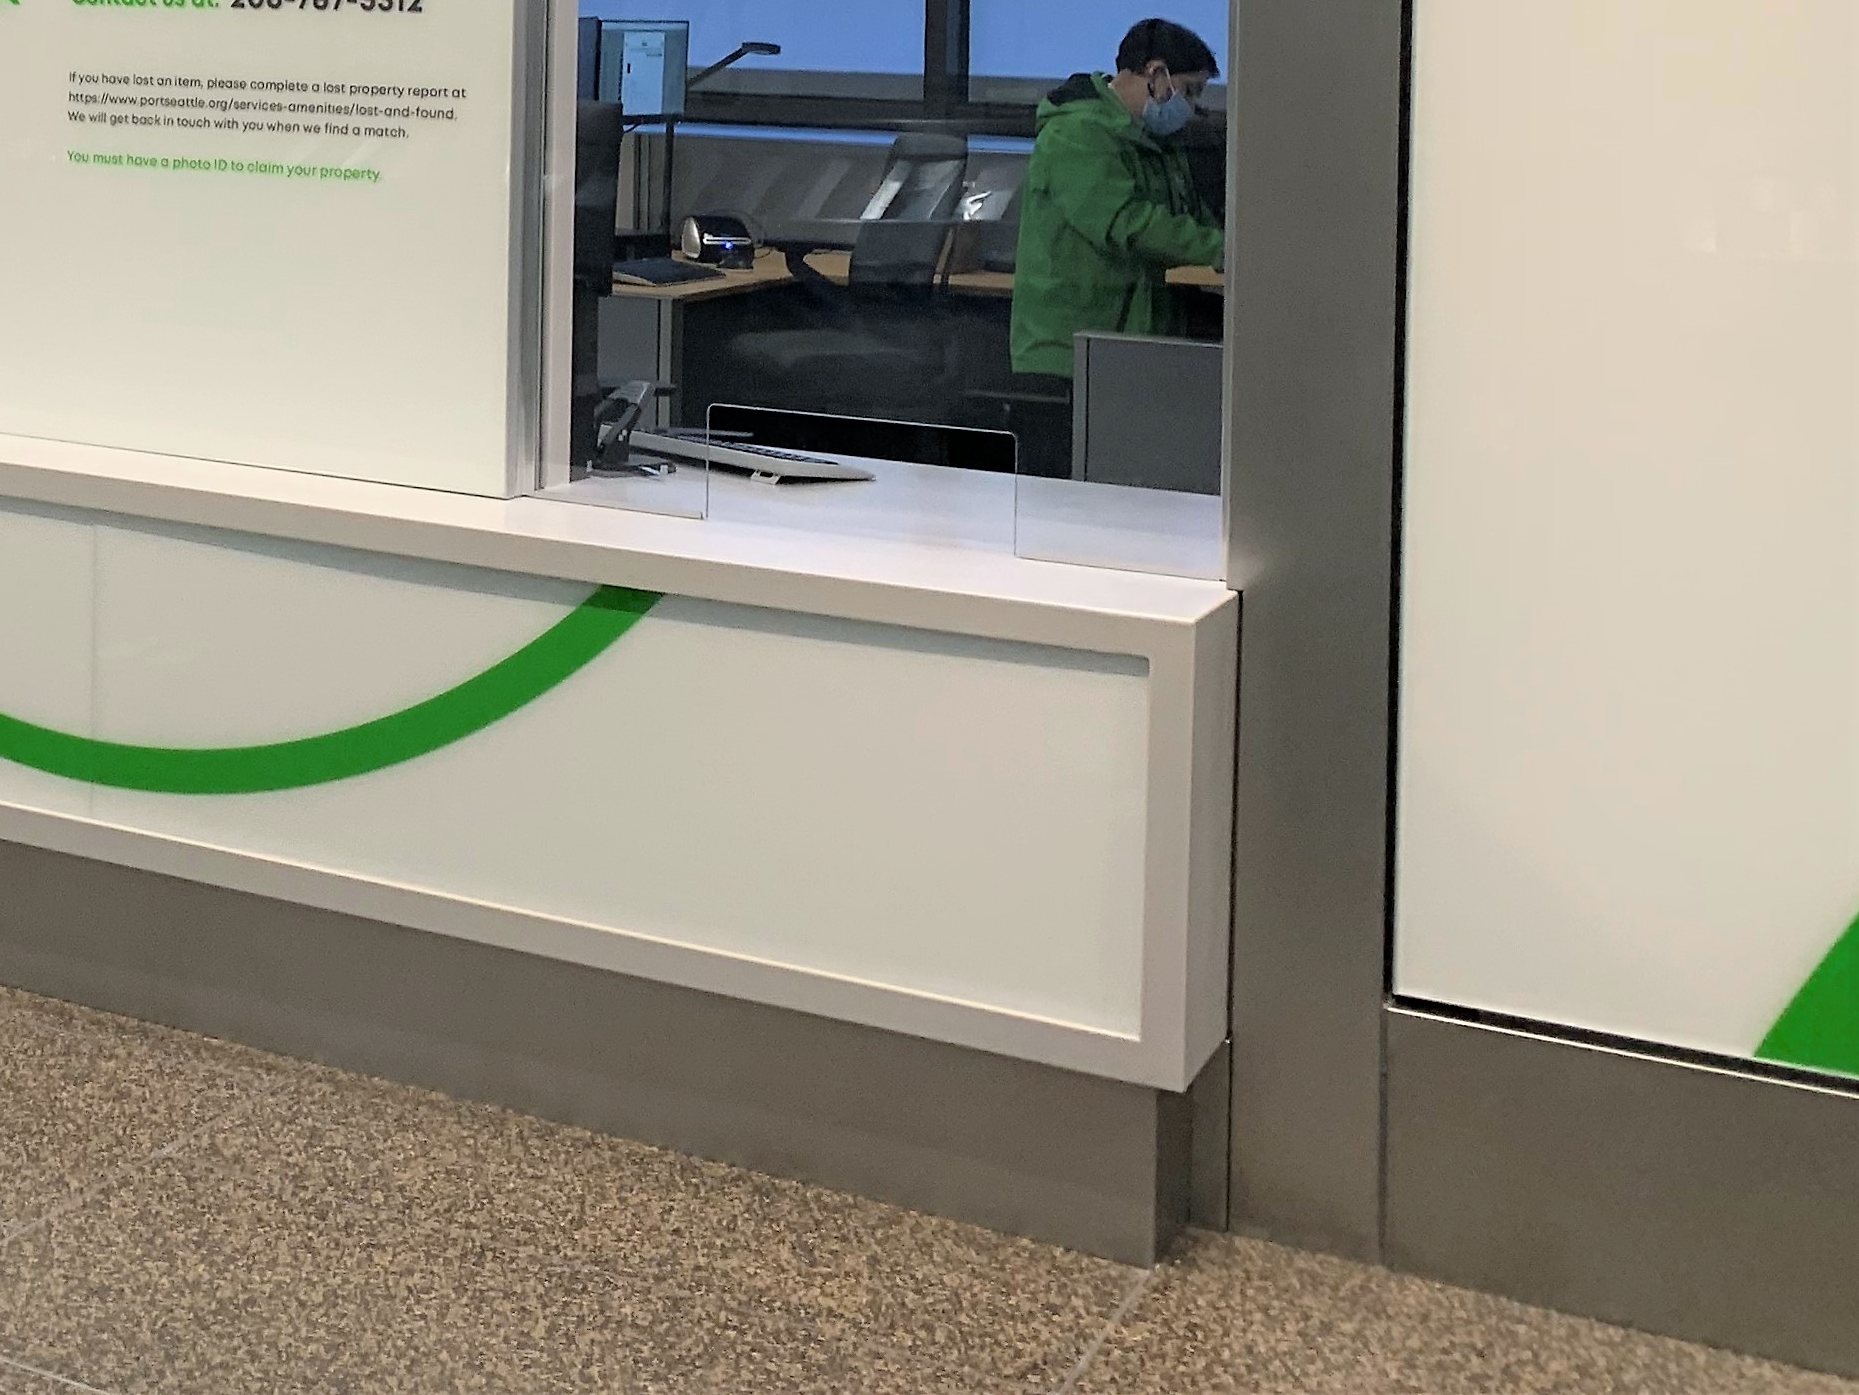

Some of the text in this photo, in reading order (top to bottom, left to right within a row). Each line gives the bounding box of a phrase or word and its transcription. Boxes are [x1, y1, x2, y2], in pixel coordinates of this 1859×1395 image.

[69, 71, 466, 98] If you have lost an item, please complete a lost property report at
[68, 111, 85, 122] We
[89, 112, 107, 123] will
[110, 114, 129, 126] get
[132, 113, 161, 125] back
[163, 115, 174, 126] in
[177, 116, 210, 128] touch
[214, 117, 239, 129] with
[242, 120, 263, 132] you
[267, 121, 299, 133] when
[303, 125, 321, 133] we
[325, 123, 348, 135] find
[352, 127, 360, 135] a
[67, 150, 89, 162] You
[93, 153, 123, 165] must
[126, 153, 157, 167] have
[161, 157, 169, 167] a
[173, 156, 211, 170] photo
[214, 158, 227, 171] ID
[231, 159, 244, 172] to
[247, 160, 284, 173] claim
[286, 164, 317, 177] your
